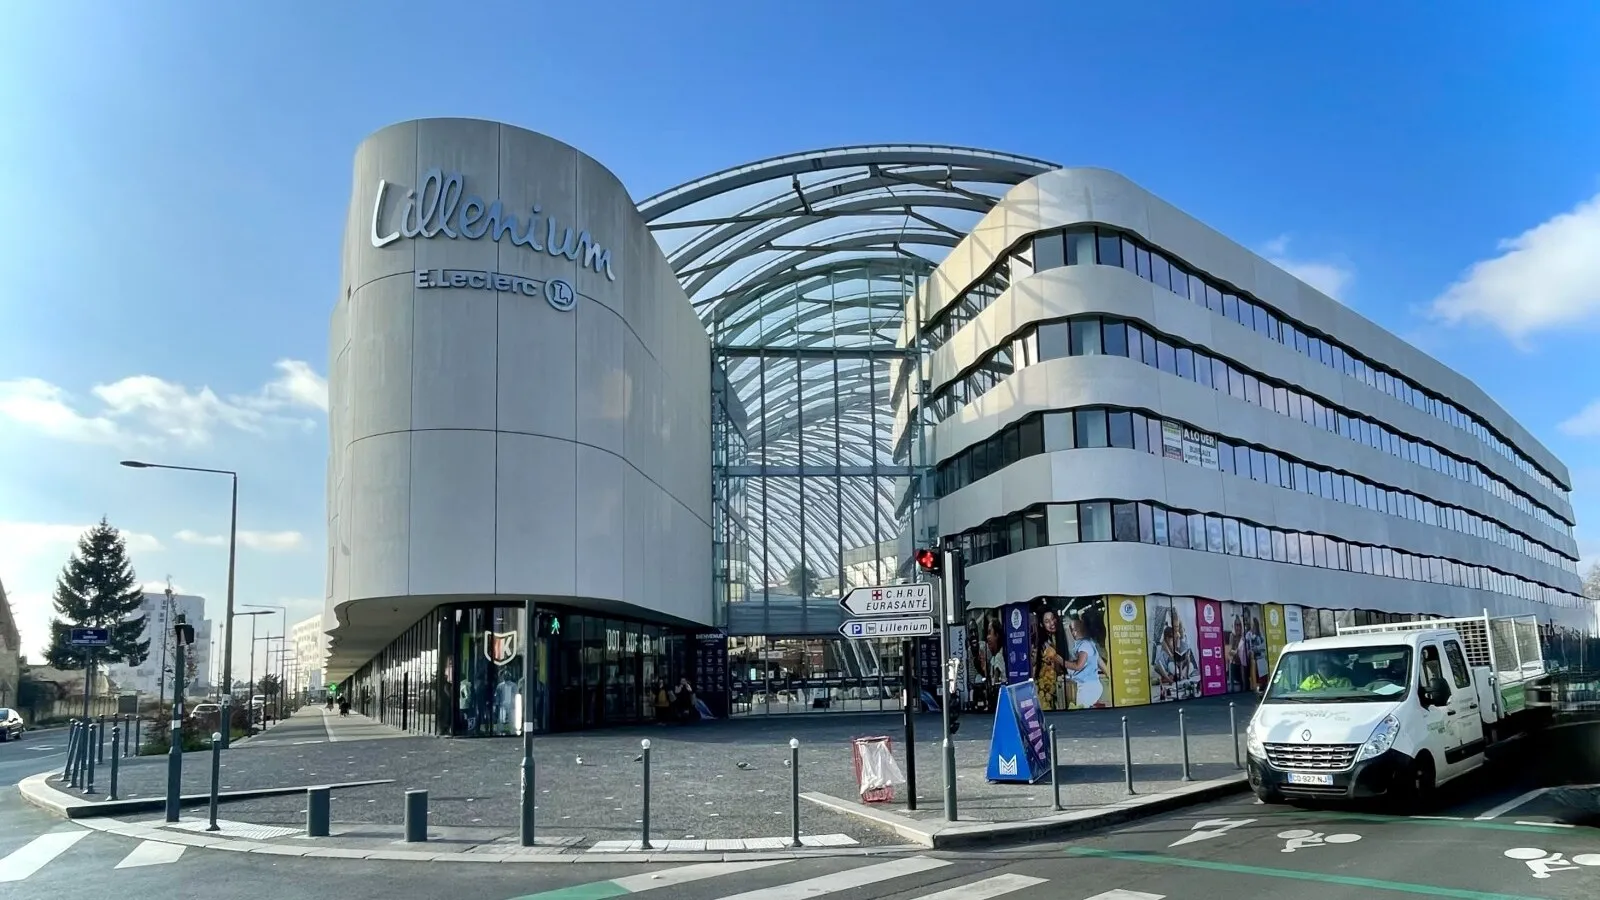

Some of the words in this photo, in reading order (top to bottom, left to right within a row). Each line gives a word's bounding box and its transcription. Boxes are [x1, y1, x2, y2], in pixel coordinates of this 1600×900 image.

[371, 168, 616, 281] Lillenium
[415, 269, 537, 296] E.Leclerc
[886, 588, 927, 599] C.H.R.U.
[866, 598, 928, 611] EURASANTÉ
[880, 622, 928, 632] Lillenium
[605, 629, 620, 651] OOT
